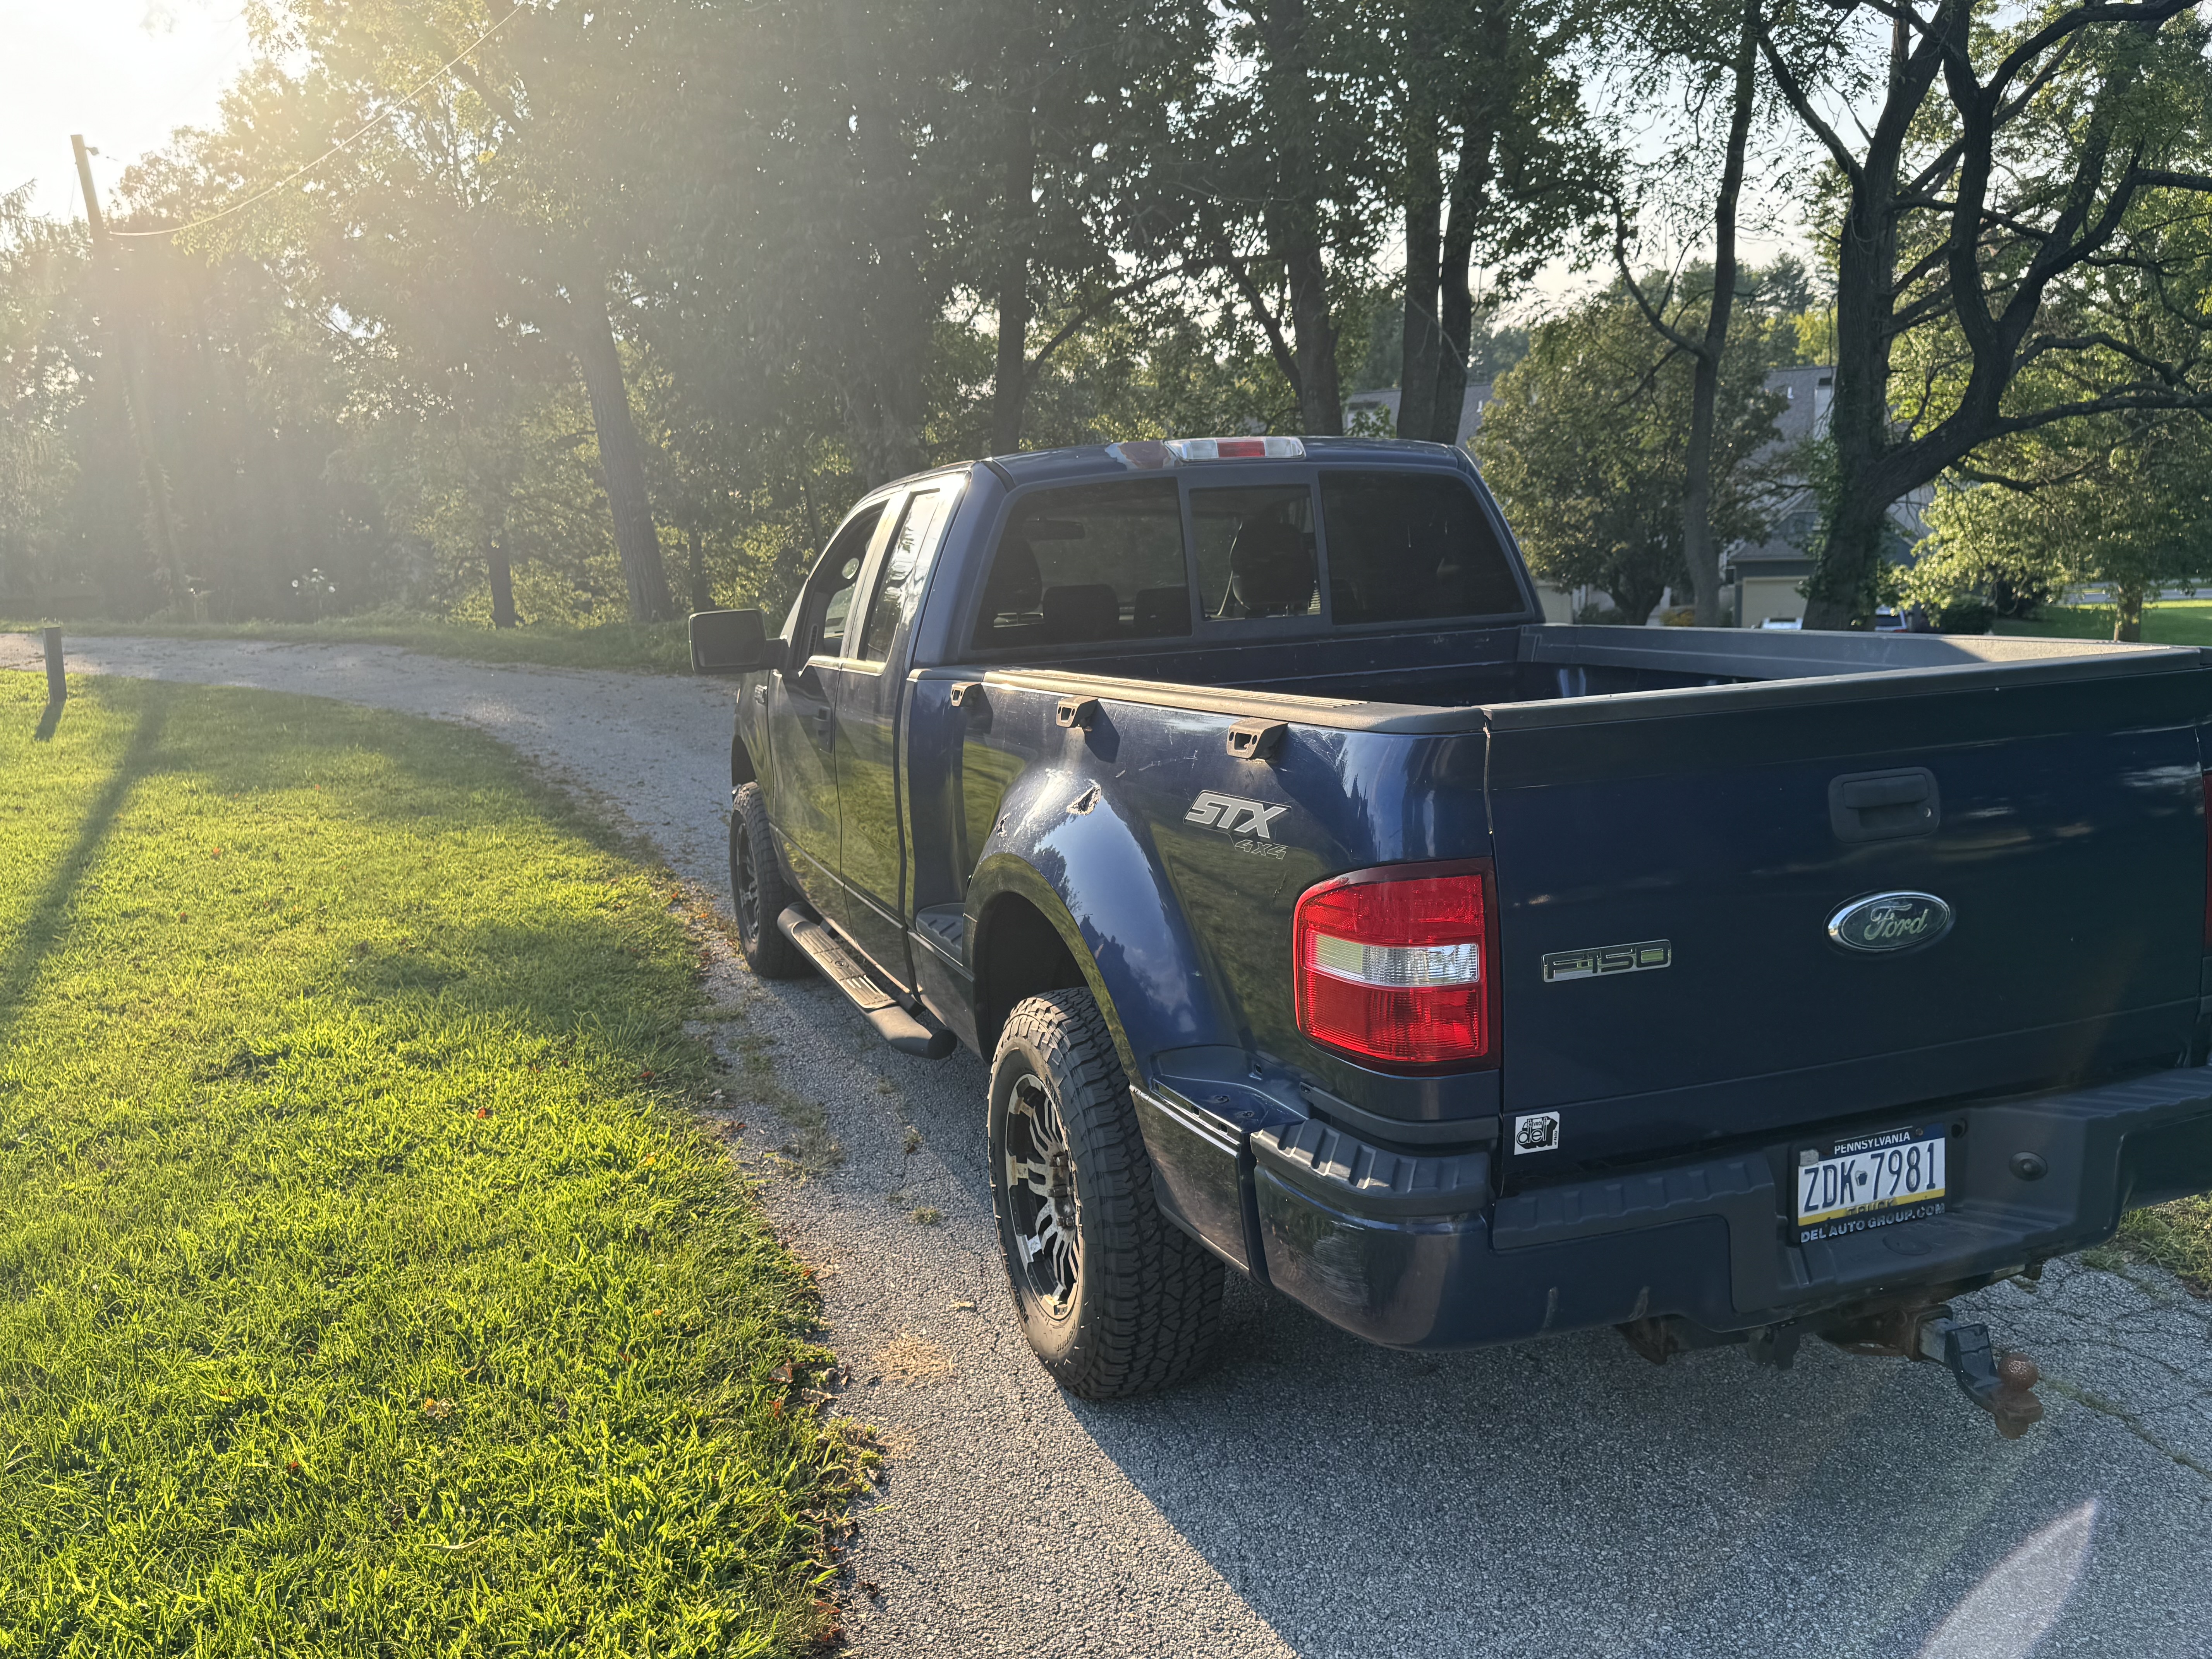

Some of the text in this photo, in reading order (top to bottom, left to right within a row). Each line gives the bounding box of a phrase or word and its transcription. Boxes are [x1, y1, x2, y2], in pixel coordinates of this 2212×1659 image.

[1184, 792, 1288, 839] STX
[1863, 903, 1929, 941] Ford
[1516, 1117, 1547, 1145] del
[1834, 1132, 1911, 1155] PENNSYLVANIA
[1800, 1228, 1827, 1243] DEL
[1829, 1219, 1865, 1237] AUTO
